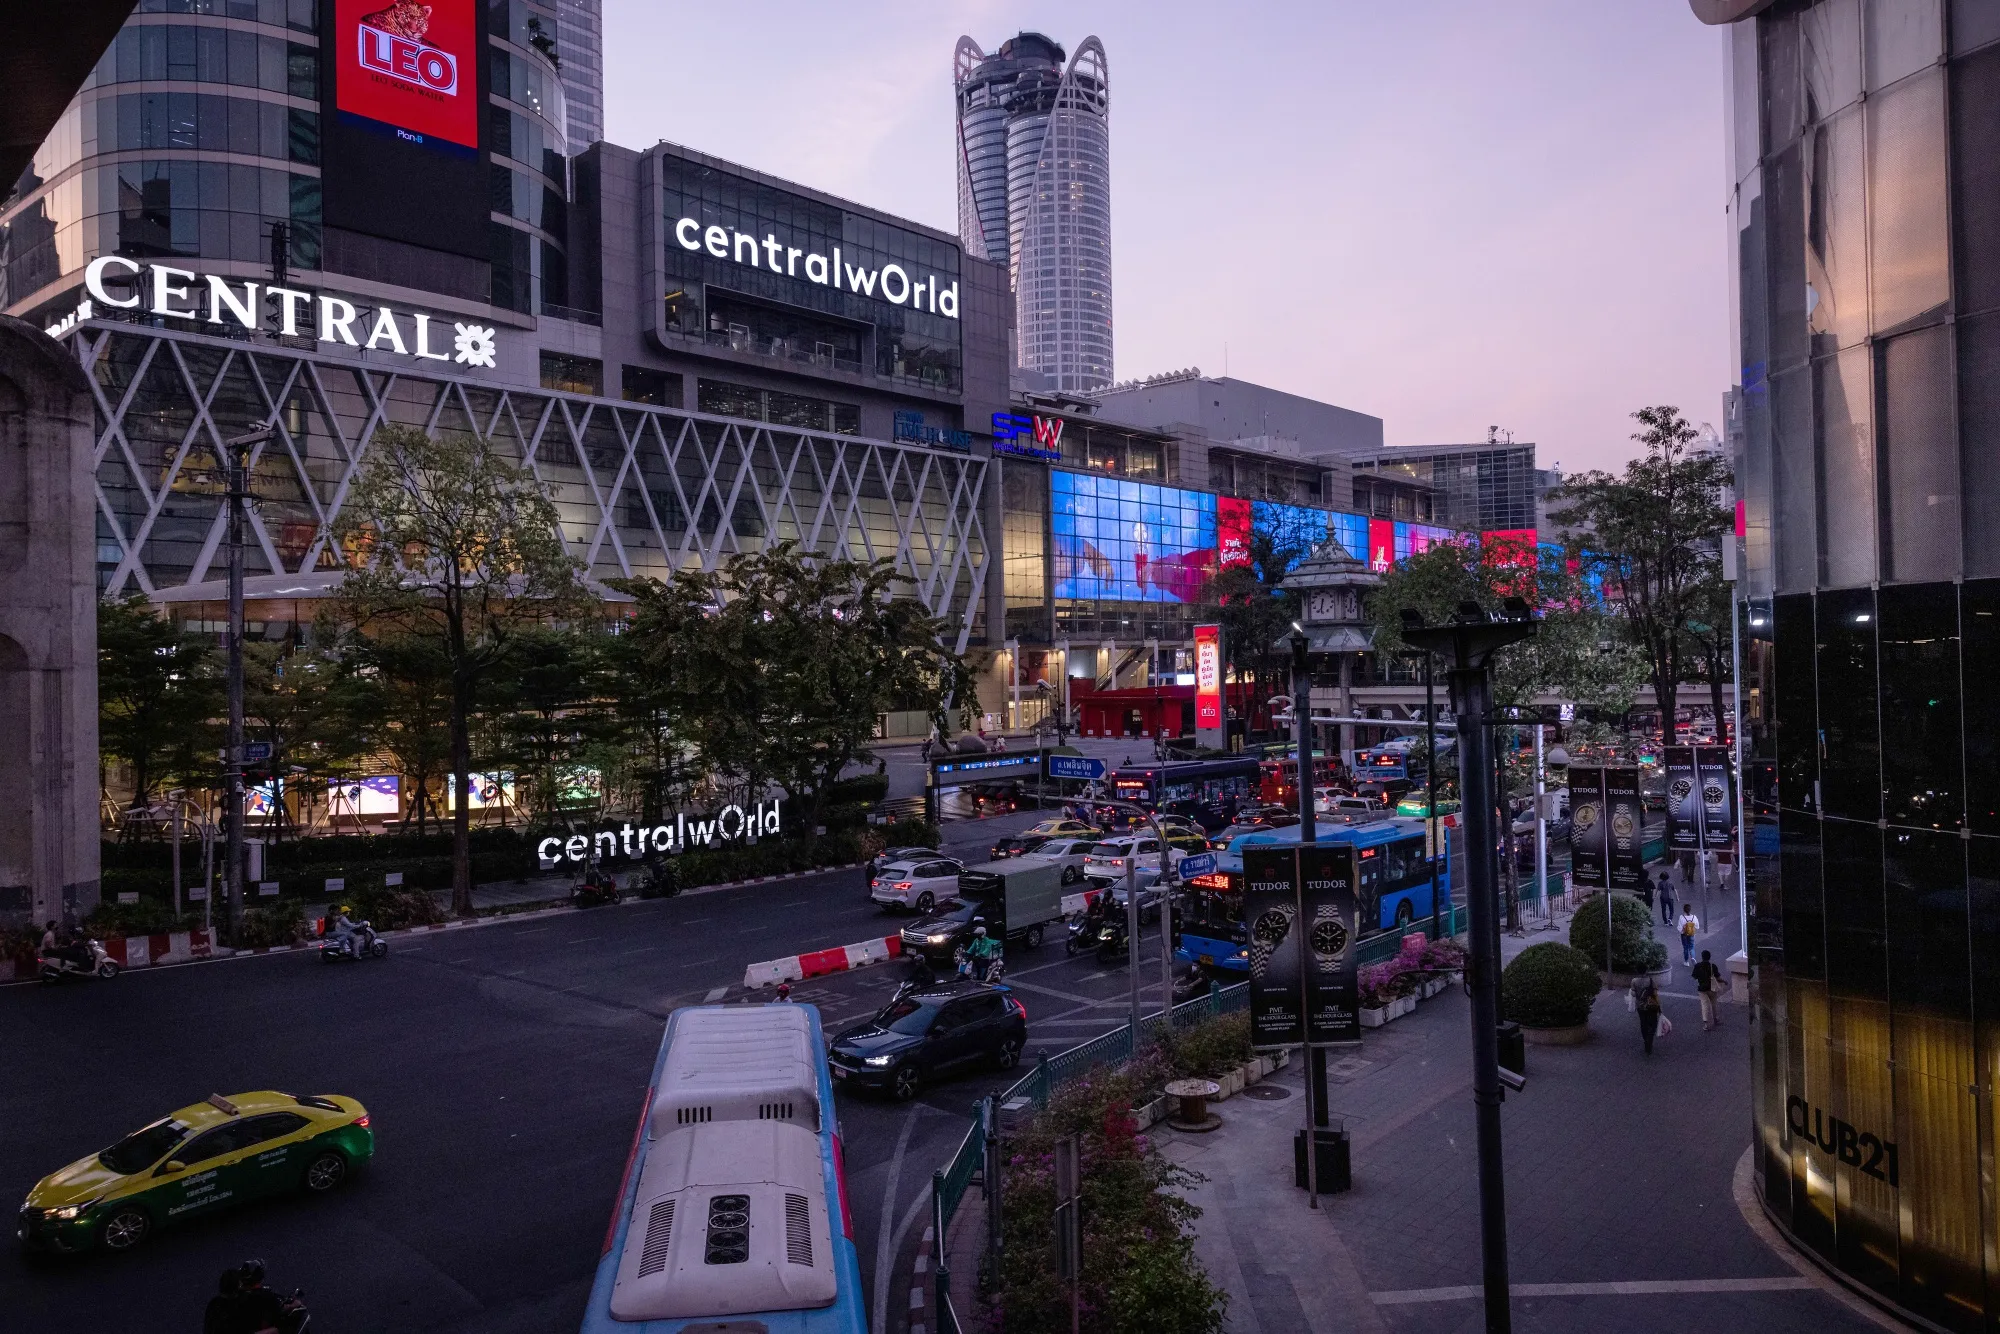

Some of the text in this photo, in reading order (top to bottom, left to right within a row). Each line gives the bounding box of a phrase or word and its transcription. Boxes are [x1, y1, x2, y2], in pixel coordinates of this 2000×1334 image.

[362, 26, 455, 90] LEO
[391, 81, 415, 95] SODA
[417, 89, 444, 103] WATER
[675, 216, 959, 320] centralwOrld
[85, 255, 449, 361] CENTRAL
[992, 441, 1024, 454] WORLD
[537, 799, 780, 864] centralwOrld
[1250, 881, 1290, 891] TUDOR
[1306, 879, 1347, 889] TUDOR
[1787, 1094, 1899, 1188] CLUB21
